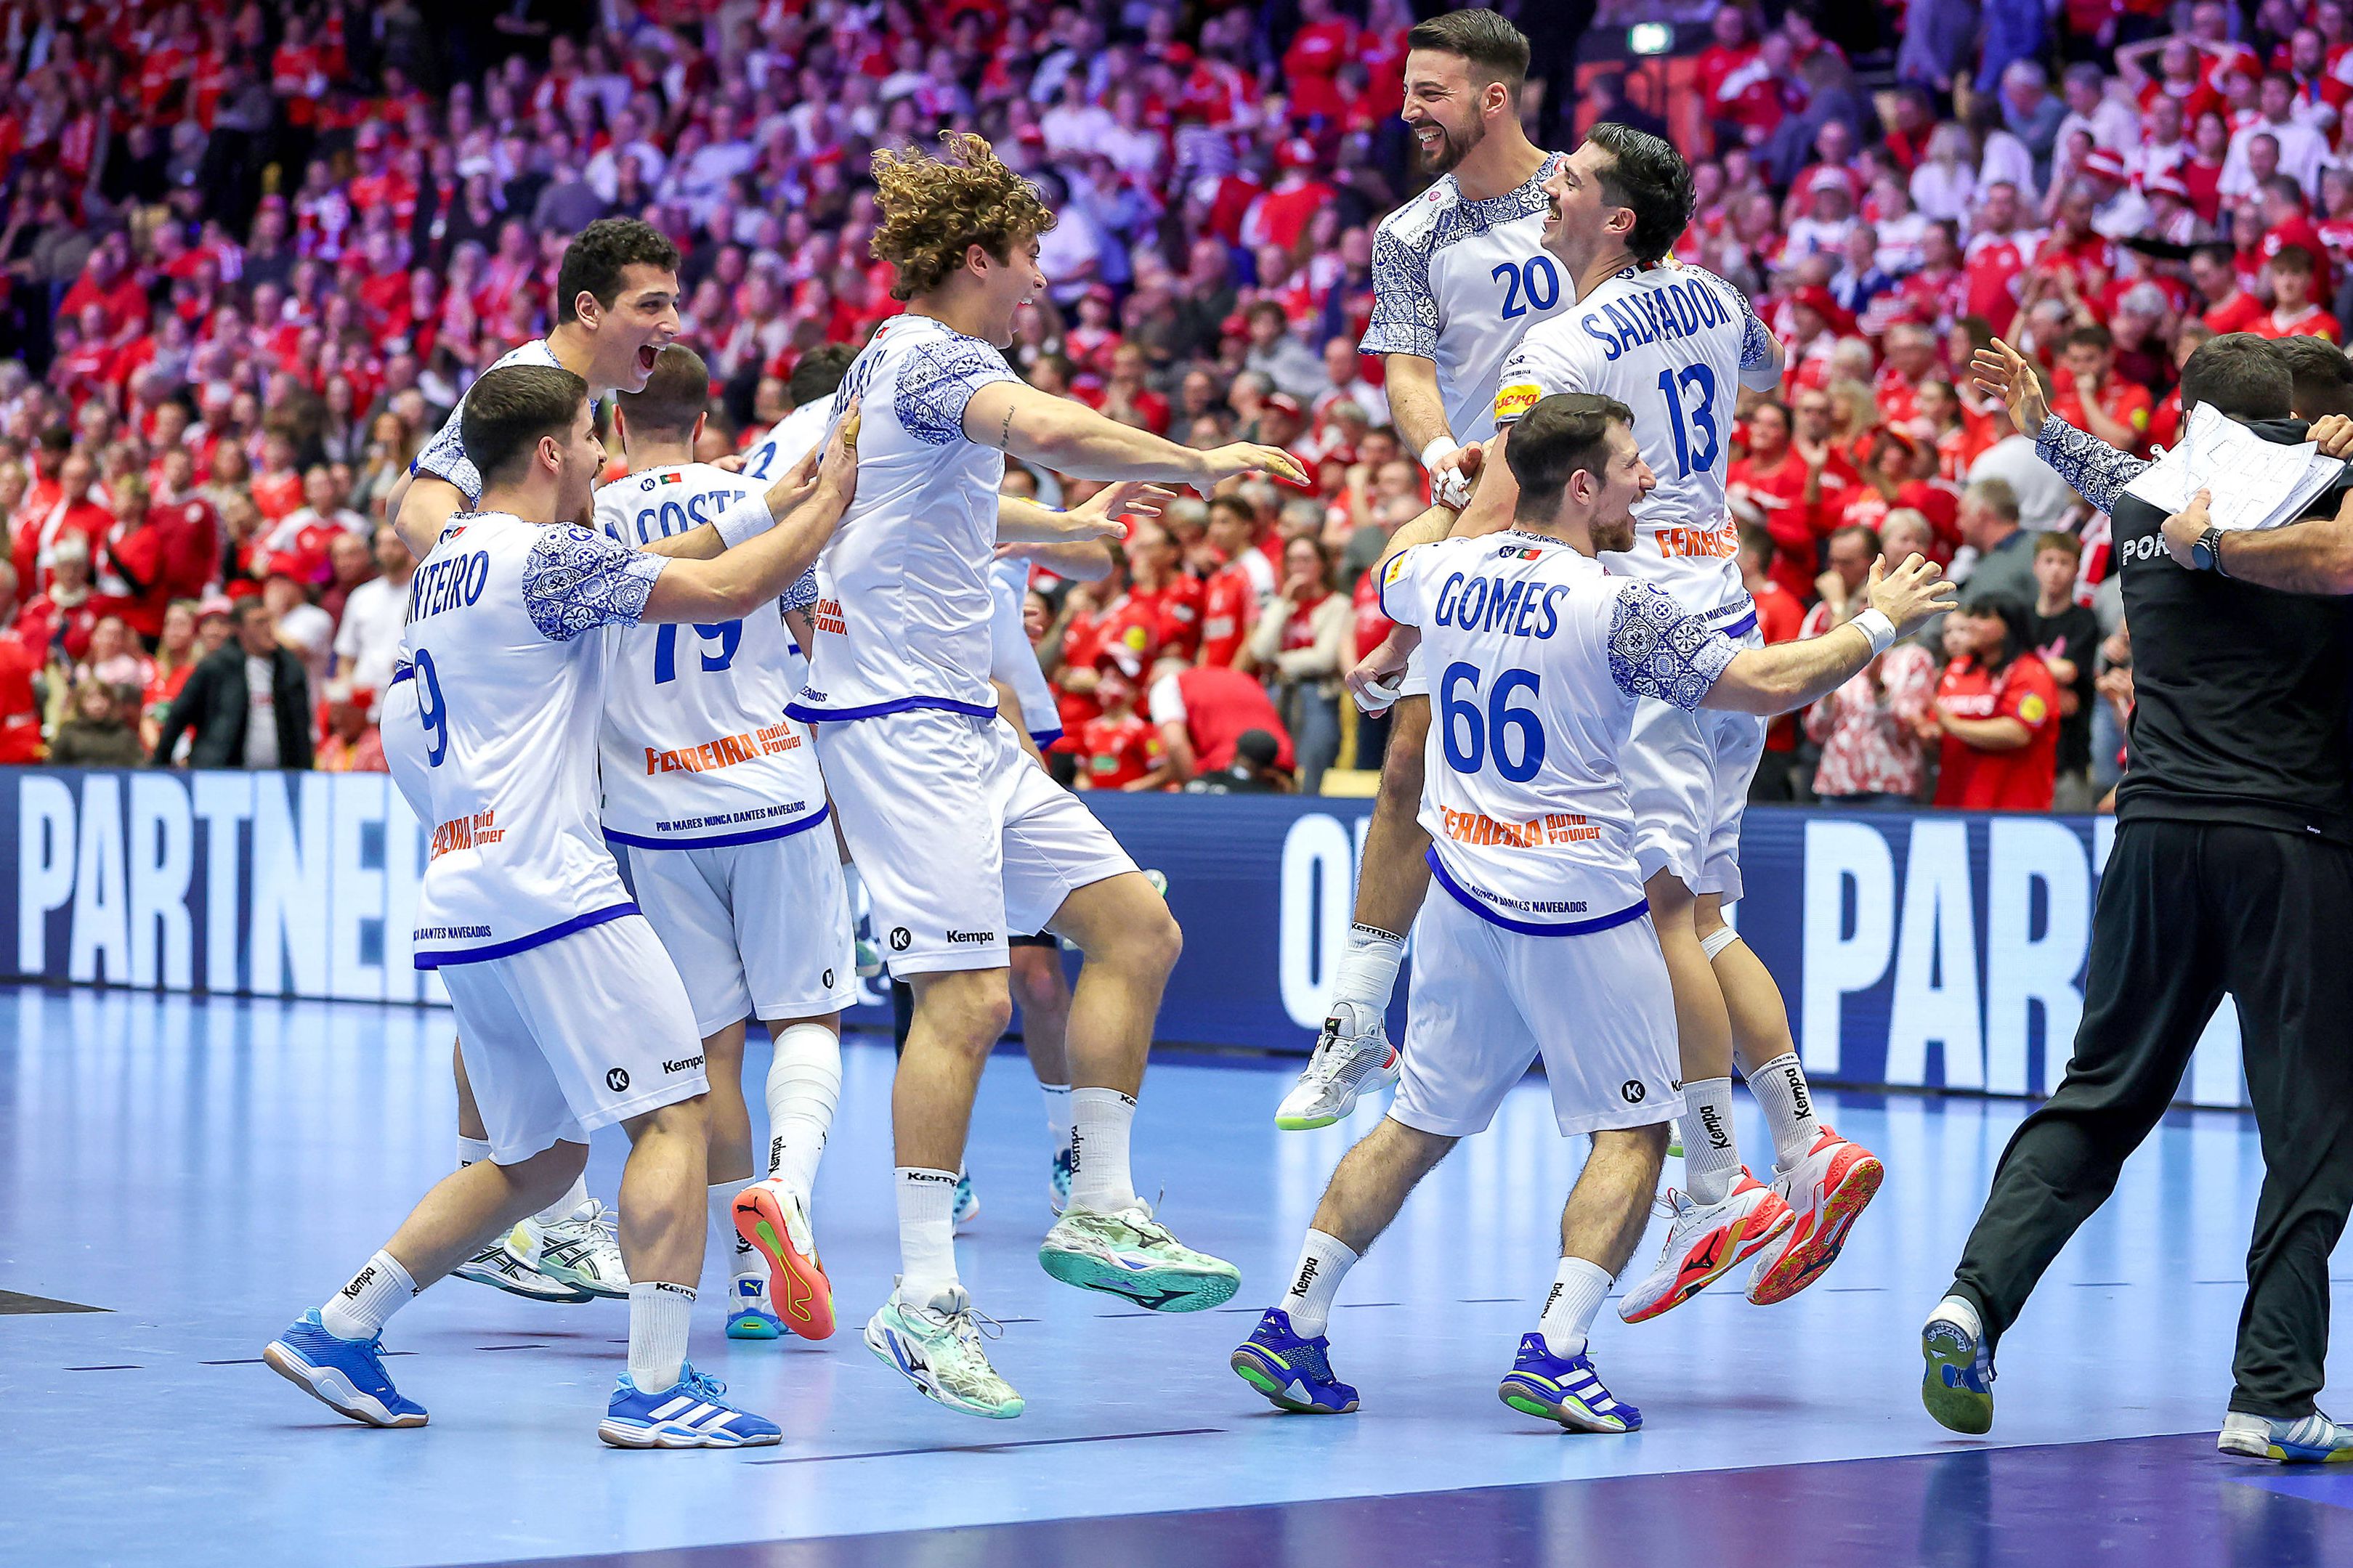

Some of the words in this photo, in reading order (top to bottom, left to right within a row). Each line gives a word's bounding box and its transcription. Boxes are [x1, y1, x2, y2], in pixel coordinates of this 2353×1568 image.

[1404, 195, 1456, 241] monchique
[1491, 256, 1560, 320] 20
[1582, 278, 1731, 361] SALVADOR
[1658, 363, 1719, 481] 13
[637, 490, 745, 545] COST
[405, 551, 489, 627] NTEIRO
[1435, 572, 1569, 640] GOMES
[415, 649, 447, 768] 9
[1441, 662, 1545, 782] 66
[756, 721, 790, 742] Build
[761, 736, 801, 755] Power
[656, 821, 671, 832] POR
[673, 818, 702, 831] MARES
[704, 813, 733, 827] NUNCA
[734, 808, 766, 823] DANTES
[766, 800, 806, 817] NAVEGADOS
[1549, 826, 1601, 845] Power
[1532, 901, 1587, 913] NAVEGADOS
[447, 925, 492, 939] NAVEGADOS
[947, 930, 995, 945] Kempa
[1351, 922, 1400, 941] Kempa
[662, 1055, 704, 1074] Kempa
[1784, 1068, 1812, 1121] Kempa
[1070, 1124, 1085, 1174] Kempa
[1699, 1105, 1732, 1150] Kempa
[341, 1267, 376, 1300] Kempa
[1290, 1256, 1319, 1298] Kempa
